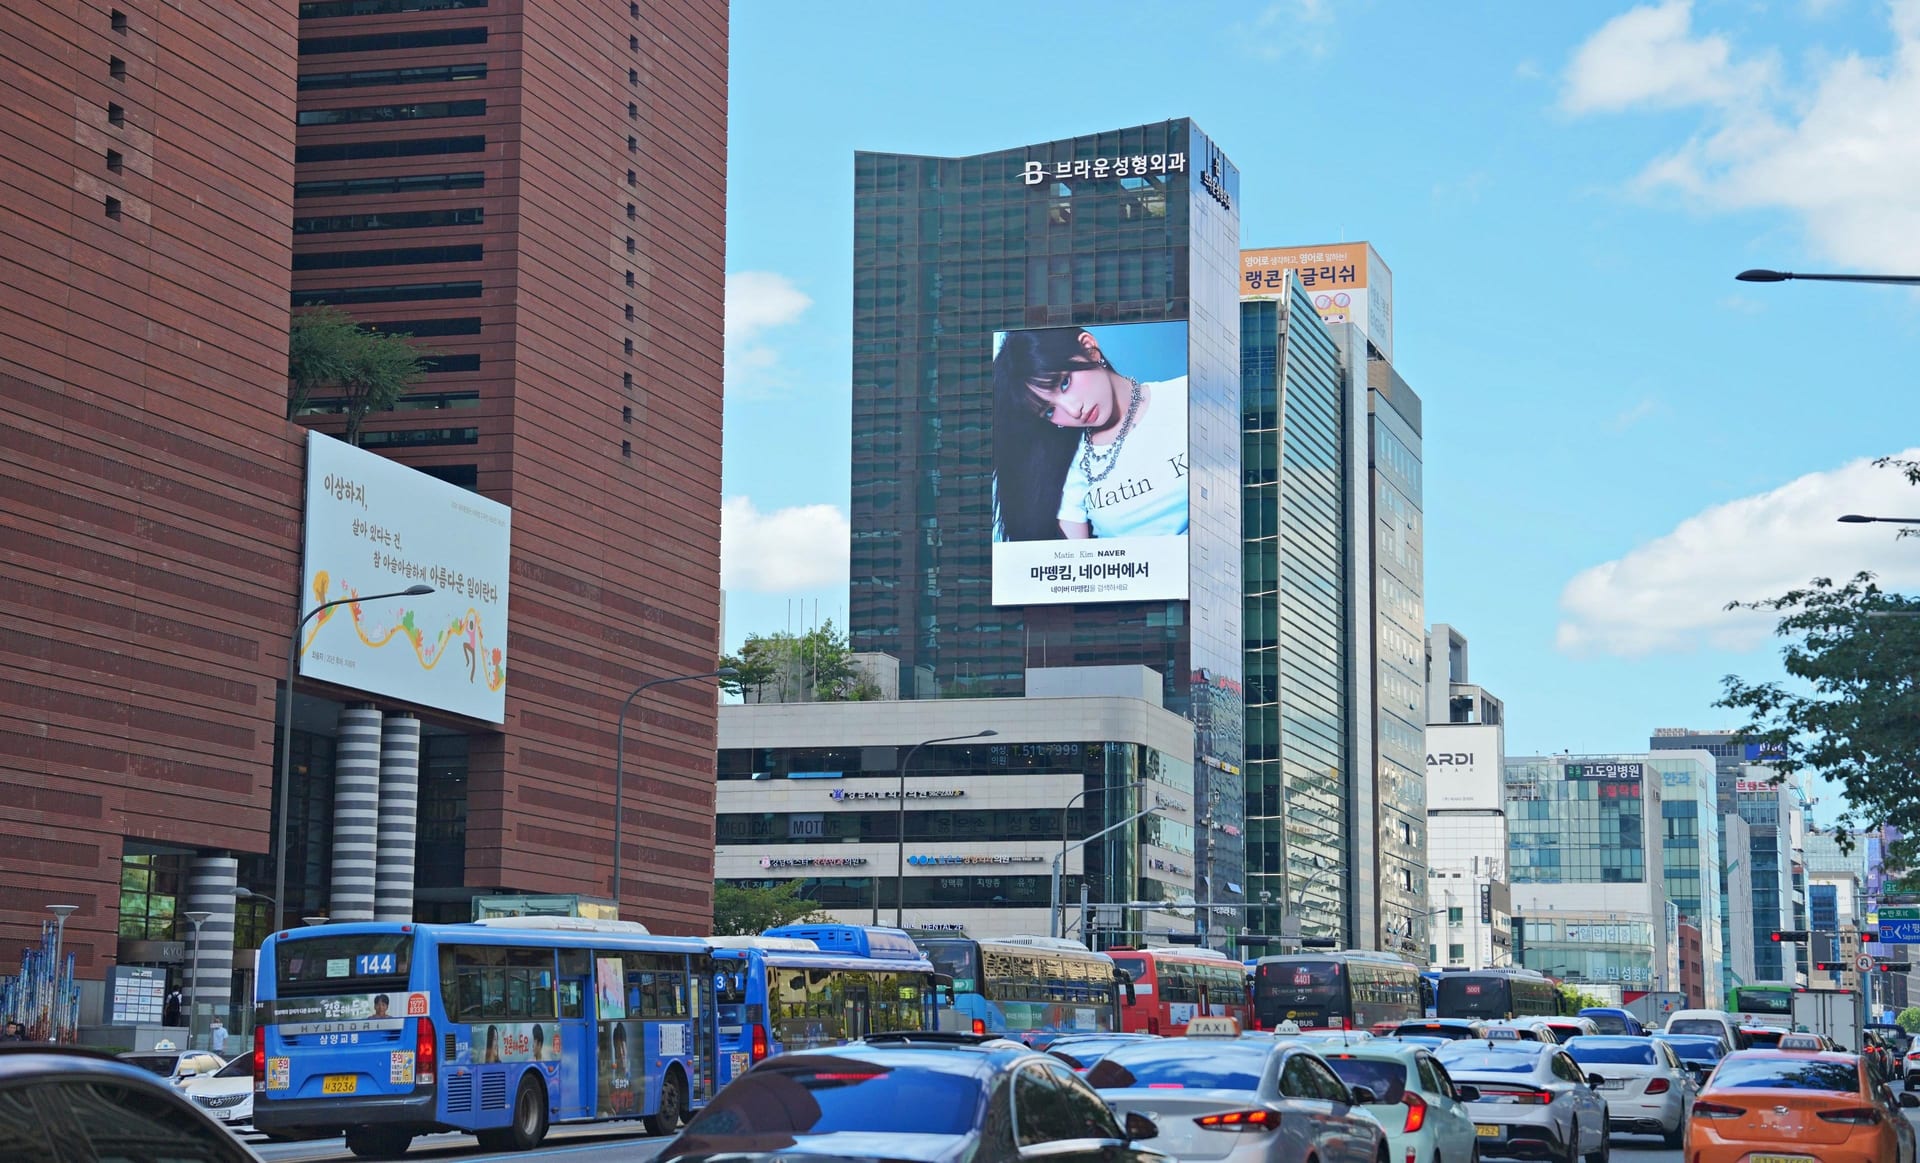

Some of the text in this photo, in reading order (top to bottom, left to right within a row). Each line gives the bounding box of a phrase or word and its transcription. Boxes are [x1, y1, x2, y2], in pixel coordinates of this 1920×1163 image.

[1024, 161, 1044, 185] B
[1055, 152, 1186, 179] 브라운성형외과
[1244, 256, 1269, 267] 영어로
[1299, 253, 1325, 264] 영어로
[1245, 264, 1356, 289] 랭콘글리쉬
[324, 473, 368, 511] 이상하지,
[1085, 478, 1154, 511] Matin
[352, 518, 367, 537] 살아
[370, 524, 391, 546] 있다는
[1054, 551, 1075, 559] Matin
[373, 551, 498, 604] 참 아슬아슬하게 아름다운 일이란다
[1031, 562, 1149, 582] 마뗑킴, 네이버에서
[1583, 764, 1640, 778] 고도일병원
[1663, 772, 1690, 787] 안과
[793, 820, 841, 835] MOTIVE
[361, 954, 392, 974] 144
[1294, 974, 1311, 985] 4401
[301, 1023, 380, 1033] HYUNDAI
[1194, 1023, 1228, 1032] TAXI
[319, 1033, 359, 1045] 삼양교통
[1786, 1039, 1814, 1047] TAXI
[330, 1082, 354, 1092] 3236
